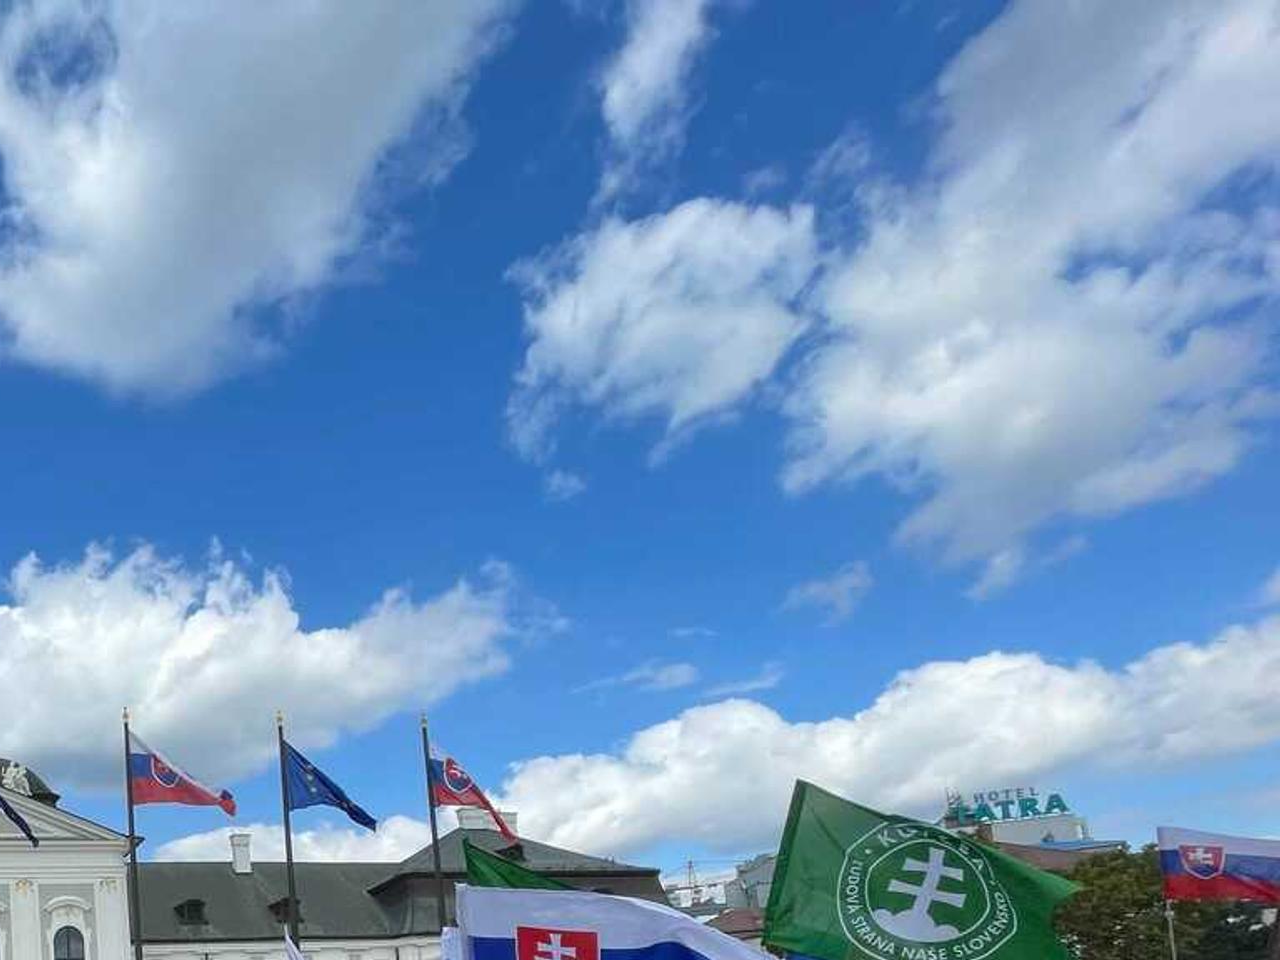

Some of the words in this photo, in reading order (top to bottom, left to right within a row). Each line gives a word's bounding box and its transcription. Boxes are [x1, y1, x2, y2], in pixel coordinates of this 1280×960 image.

[973, 787, 1040, 803] HOTEL
[851, 915, 896, 955] STRANA
[901, 946, 948, 960] NAŠE
[952, 892, 1009, 958] SLOVENSKO
